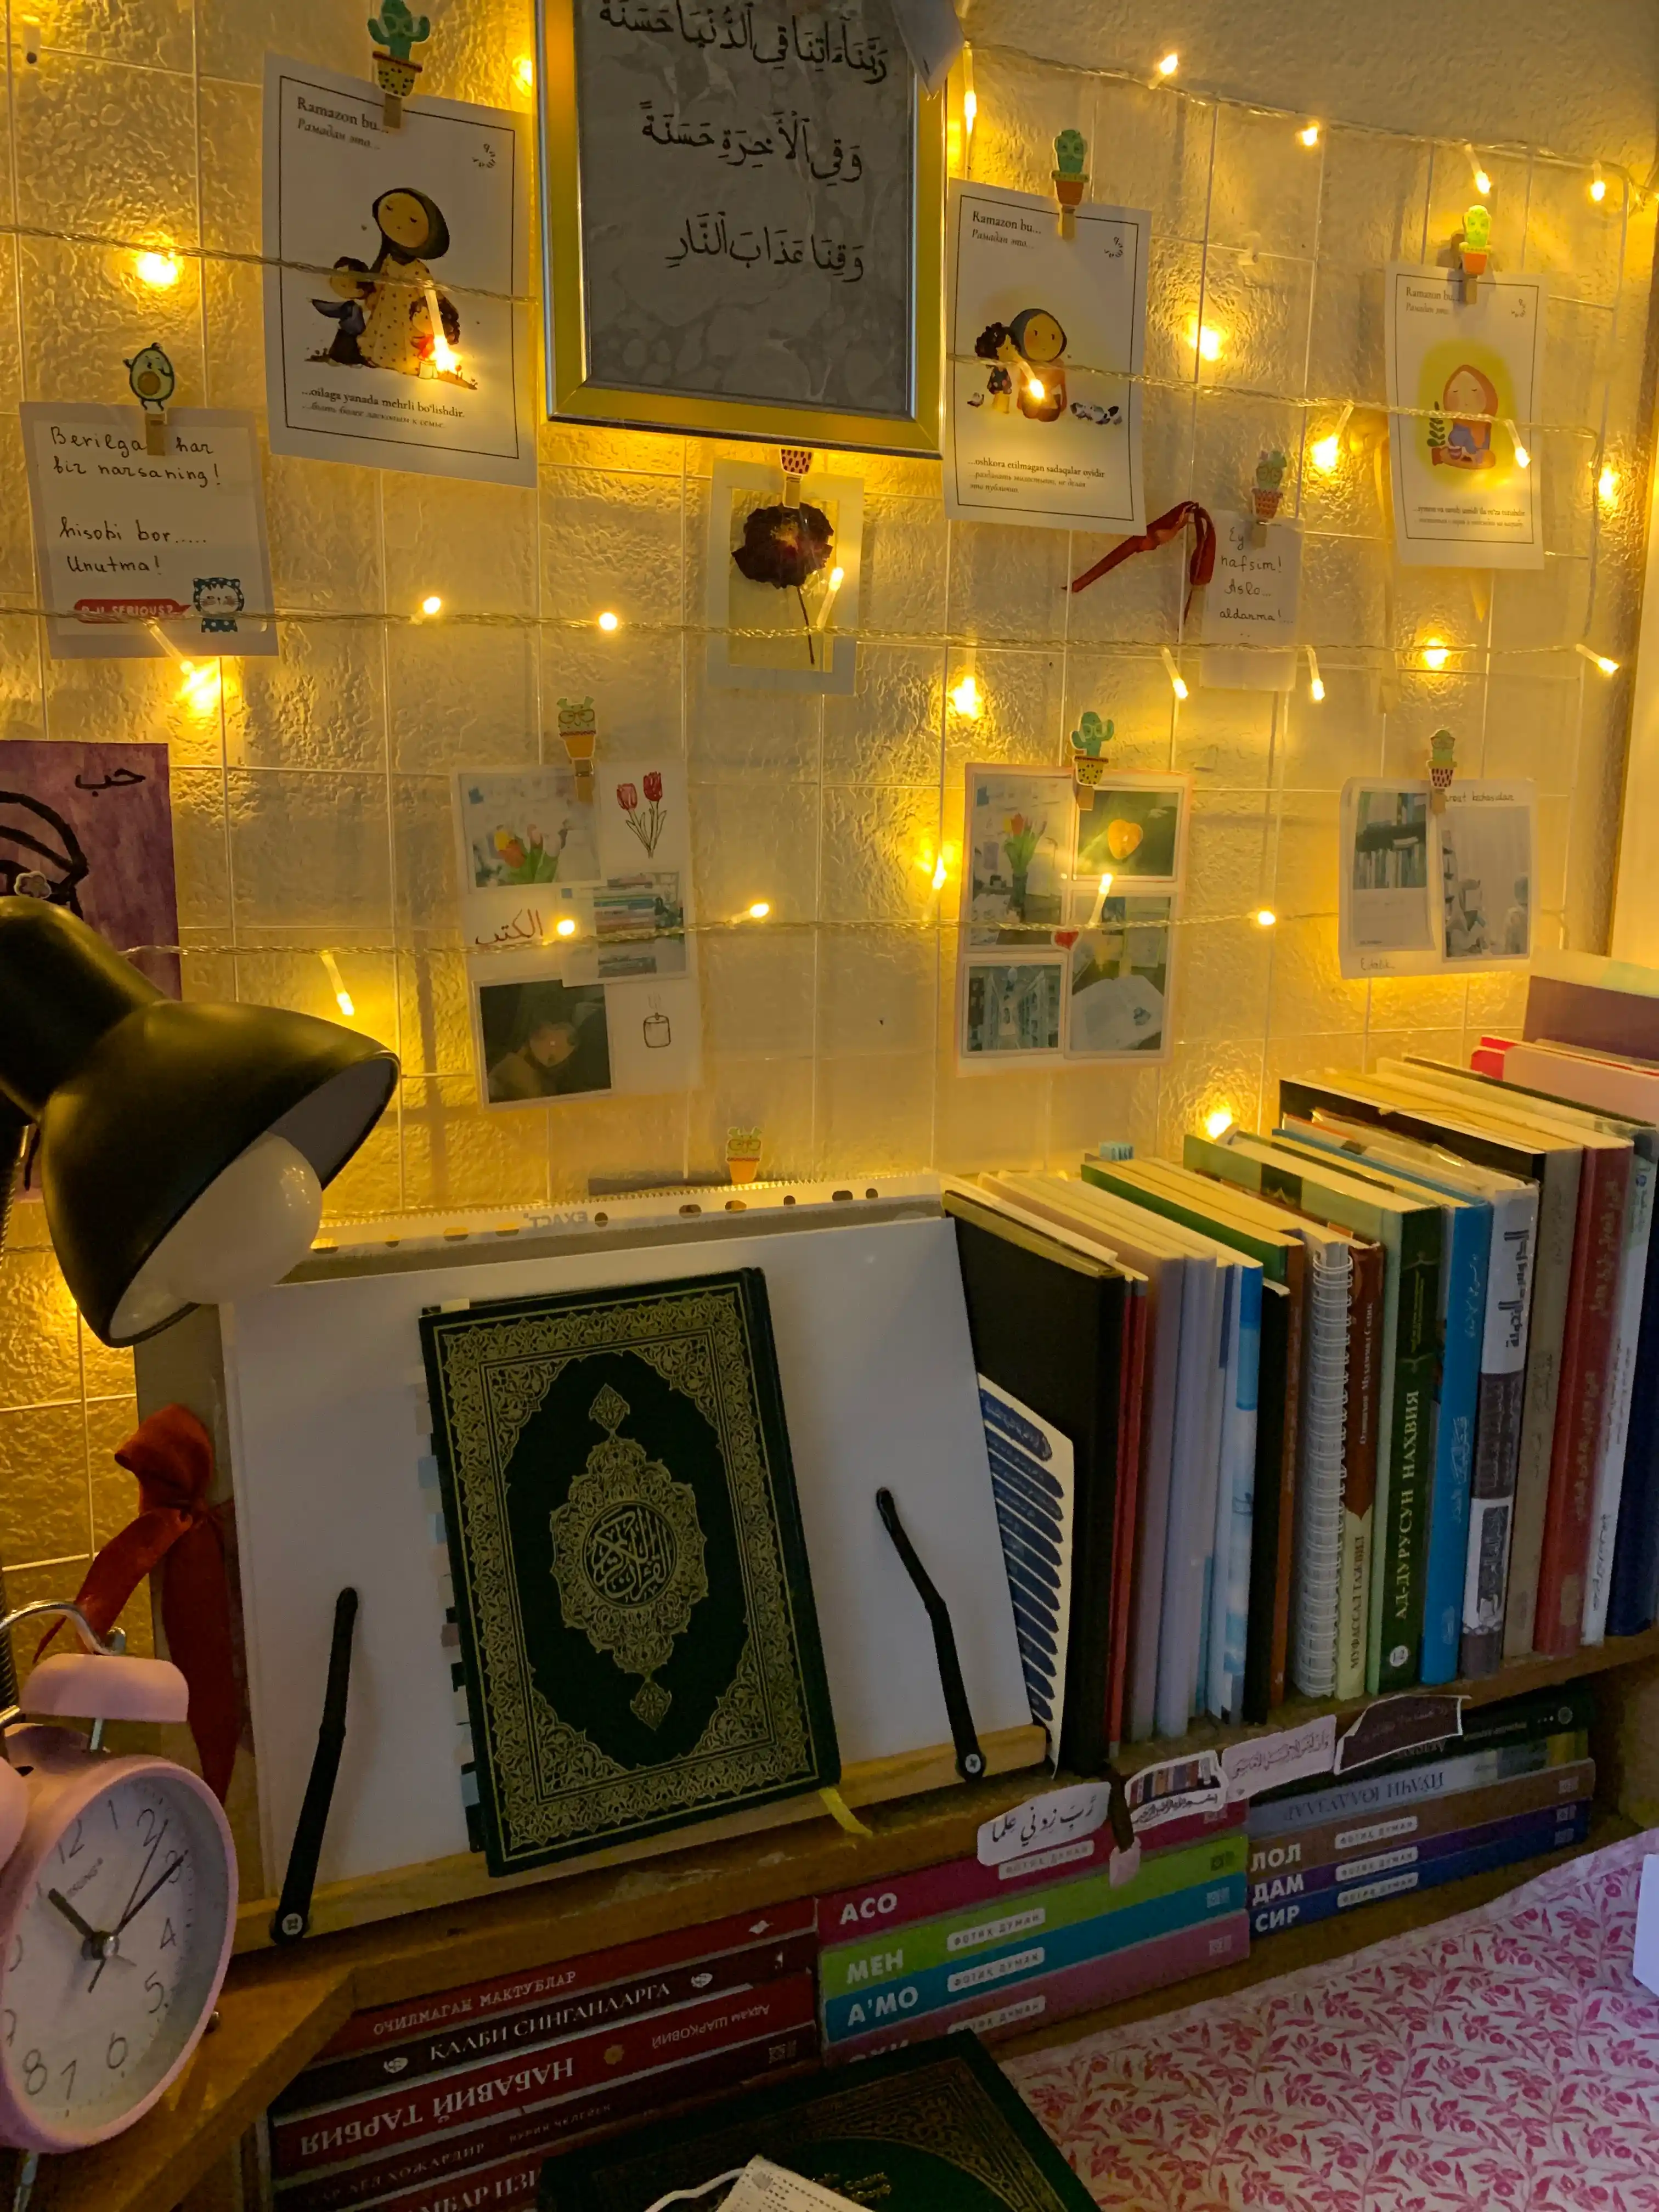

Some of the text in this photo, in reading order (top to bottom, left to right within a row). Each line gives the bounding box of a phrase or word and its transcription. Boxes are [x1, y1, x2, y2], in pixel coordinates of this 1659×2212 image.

[297, 95, 358, 126] Ramazon
[972, 209, 1018, 229] Ramazon
[343, 393, 379, 406] yanada
[381, 398, 415, 411] mehrli
[176, 437, 215, 455] har
[52, 456, 87, 475] bir
[1007, 460, 1045, 473] etilmagan
[1046, 464, 1081, 477] sadaqalar
[60, 516, 122, 541] hisobi
[1395, 1389, 1420, 1621] АД-ДУРУСУН НАХВИЯ
[108, 1799, 119, 1830] 1
[137, 1808, 160, 1847] 2
[57, 1819, 85, 1864] 12
[1249, 1843, 1301, 1872] ЛОЛ
[1252, 1874, 1305, 1908] ДАМ
[839, 1892, 898, 1925] АСО
[1255, 1904, 1301, 1934] СИР
[160, 1917, 177, 1949] 4
[846, 1948, 905, 1985] МЕН
[145, 1971, 165, 2013] 5
[373, 1970, 578, 2037] ОЧИЛМАГАН МАКТУБЛАР
[514, 1982, 672, 2039] СИНГАНЛАРГА
[106, 2032, 128, 2070] 6
[22, 2049, 47, 2096] 8
[300, 2057, 574, 2157] НАБАВИЙ ТАРБИЯ
